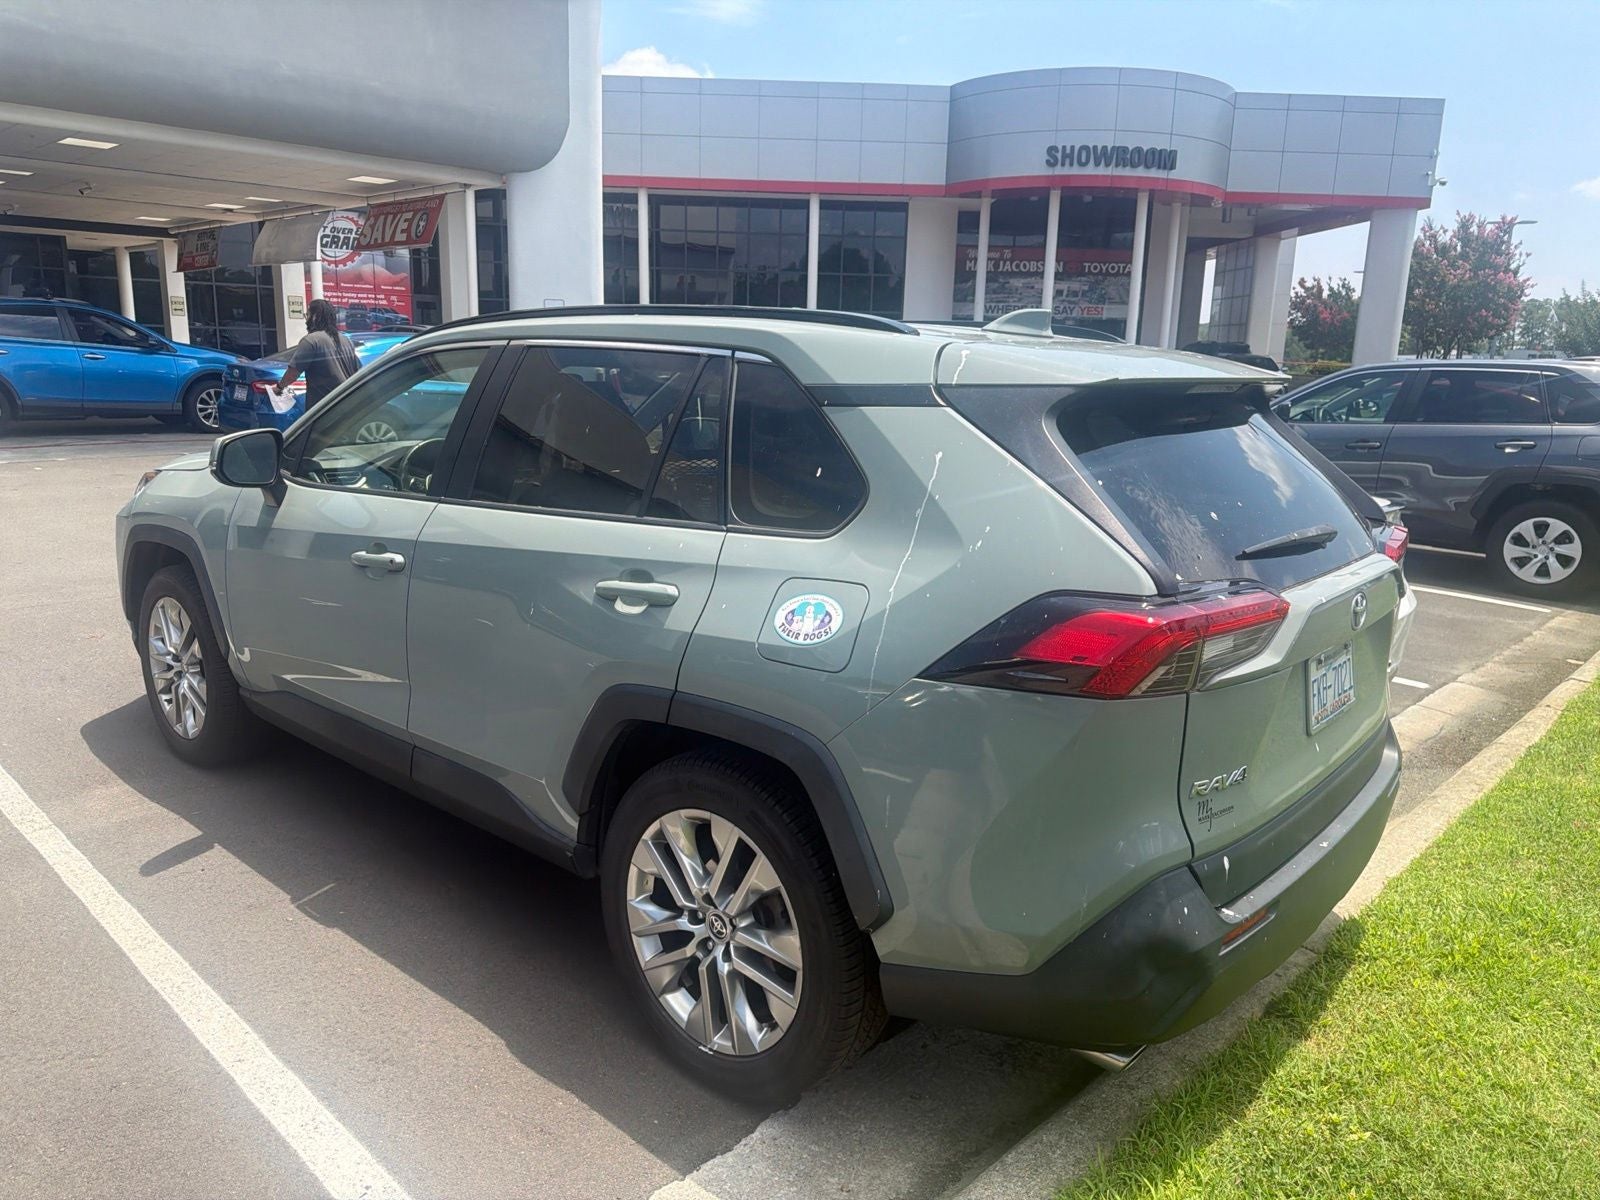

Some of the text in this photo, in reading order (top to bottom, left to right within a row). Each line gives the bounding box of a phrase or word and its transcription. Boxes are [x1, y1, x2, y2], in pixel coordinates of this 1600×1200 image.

[1044, 144, 1178, 171] SHOWROOM
[329, 226, 353, 236] OVER
[359, 211, 414, 246] SAVE
[997, 260, 1064, 273] JACOBSN
[1083, 262, 1132, 274] TOYOTA
[1053, 305, 1075, 317] SAY
[1079, 306, 1104, 317] YES!
[778, 622, 833, 642] THEIR DOGS!
[1190, 765, 1248, 799] RAV4
